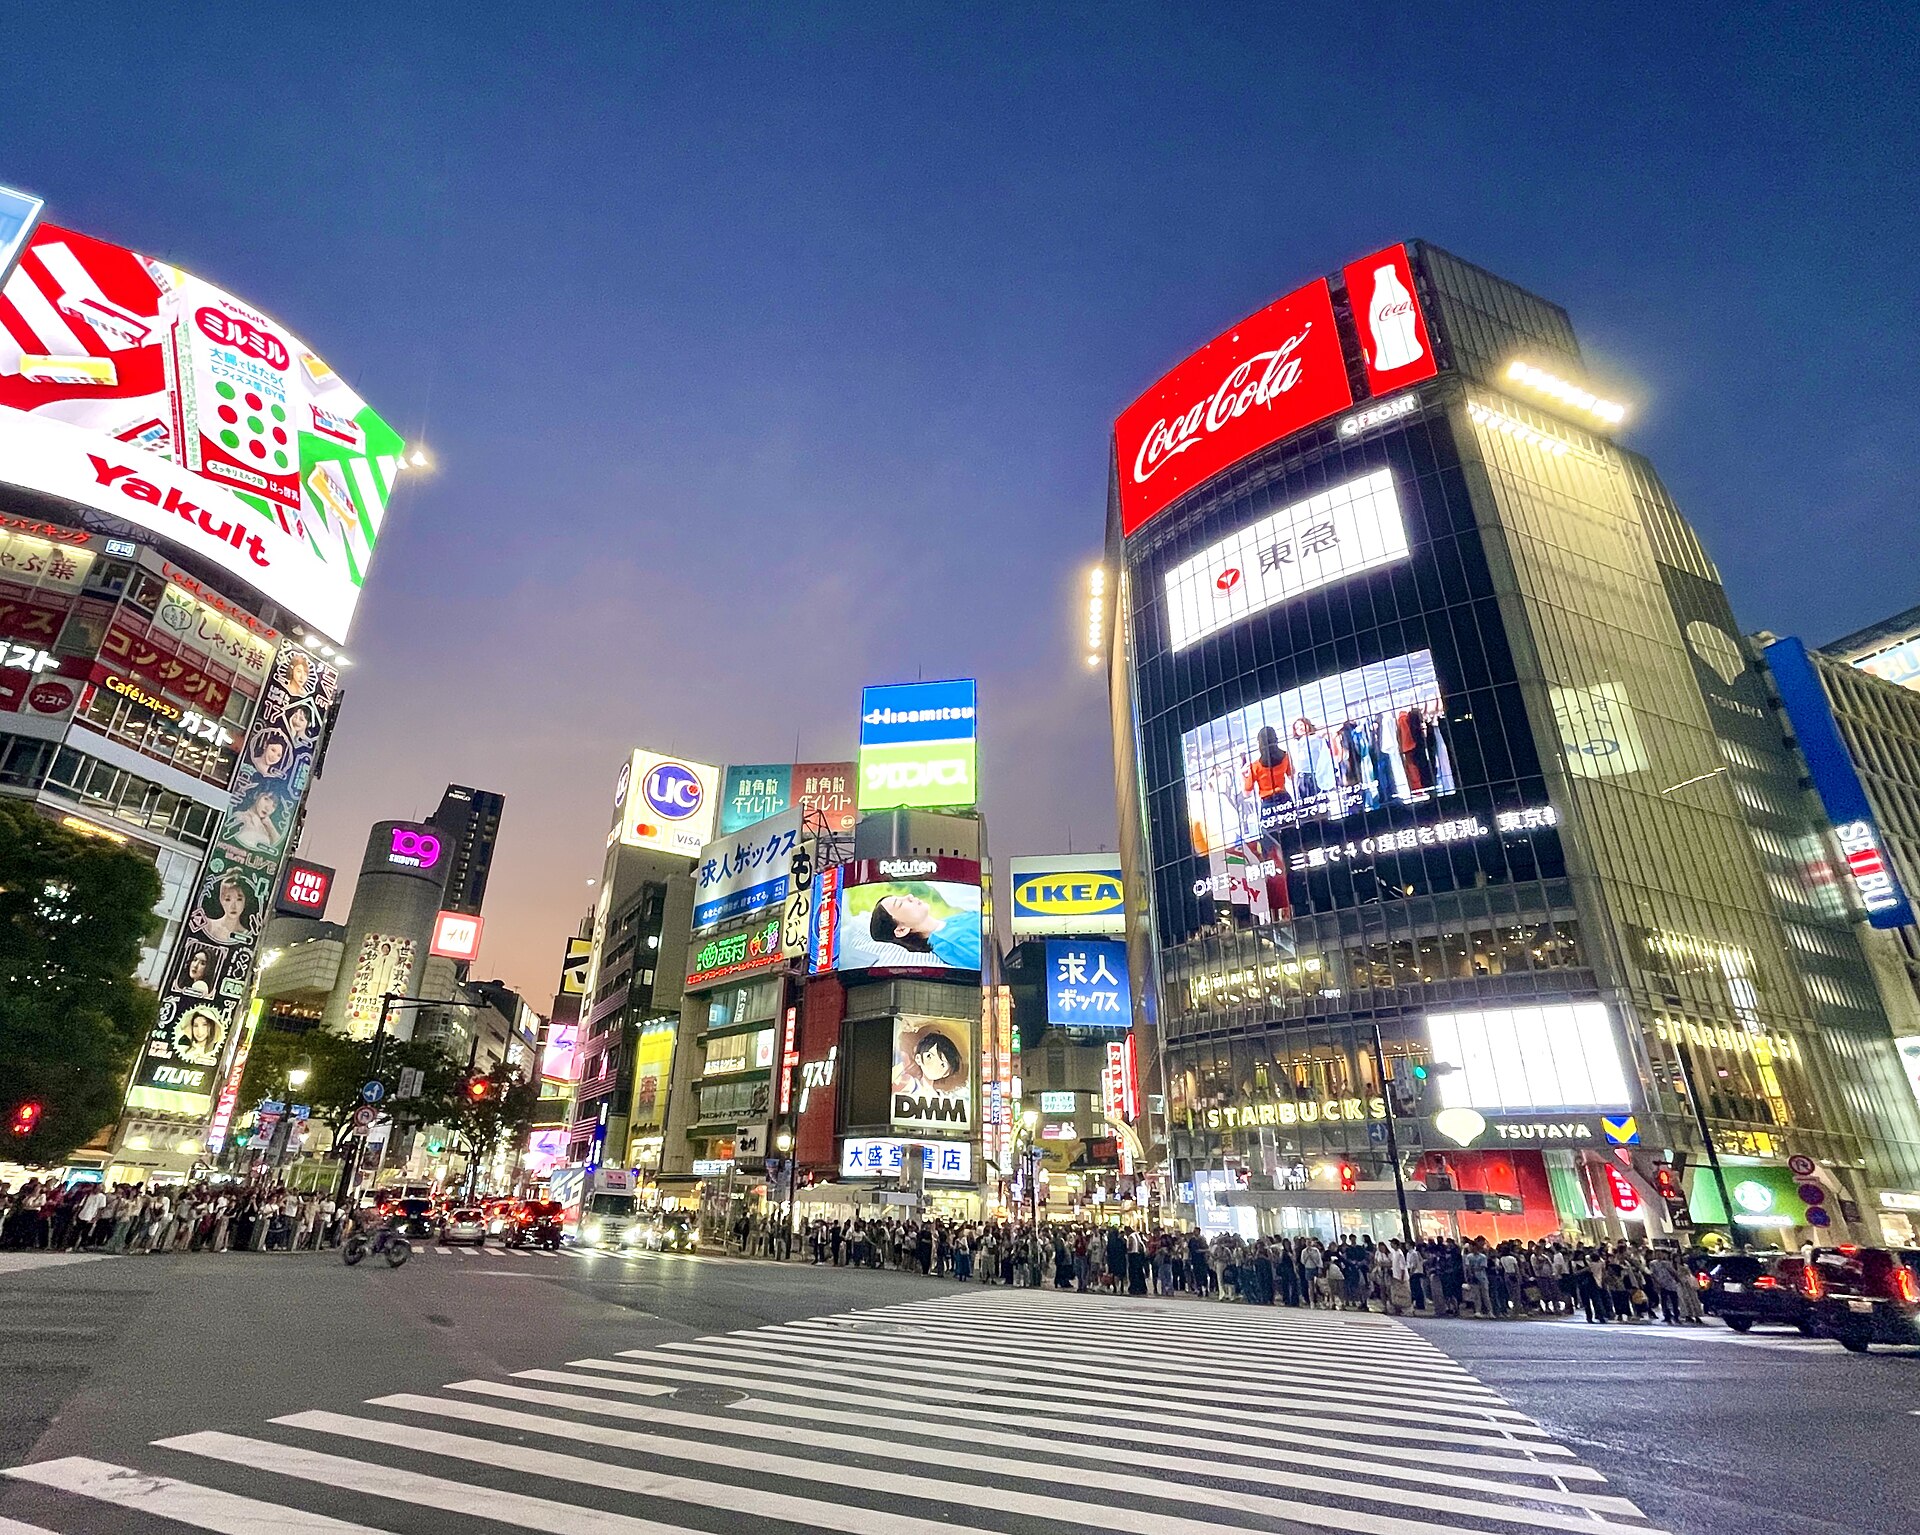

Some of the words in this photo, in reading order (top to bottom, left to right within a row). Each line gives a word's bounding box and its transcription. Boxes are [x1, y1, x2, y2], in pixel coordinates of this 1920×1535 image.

[219, 299, 268, 328] Yakult
[203, 312, 286, 365] ミルミル
[1342, 395, 1415, 435] QFRONT
[86, 453, 270, 567] Yakult
[1258, 520, 1340, 576] 東急
[198, 616, 265, 671] しゃぶ葉
[104, 630, 224, 703] コンタクト
[178, 710, 234, 747] ガスト
[864, 706, 974, 725] Hisamitsu
[391, 828, 440, 868] 109
[677, 834, 701, 847] VISA
[700, 829, 797, 889] 求人ボックス
[879, 859, 937, 876] Rakuten
[290, 886, 320, 904] QLO
[293, 871, 322, 889] UNI
[1025, 884, 1121, 903] IKEA
[785, 846, 812, 952] もんじゃ
[717, 941, 747, 966] 西村
[1057, 953, 1118, 985] 求人
[1058, 989, 1120, 1012] ボックス
[153, 1065, 205, 1086] 17LIVE
[1111, 1050, 1123, 1103] カラオケ
[893, 1094, 967, 1123] DMM
[1207, 1098, 1387, 1128] STARBUCKS
[1495, 1123, 1591, 1139] TSUTAYA
